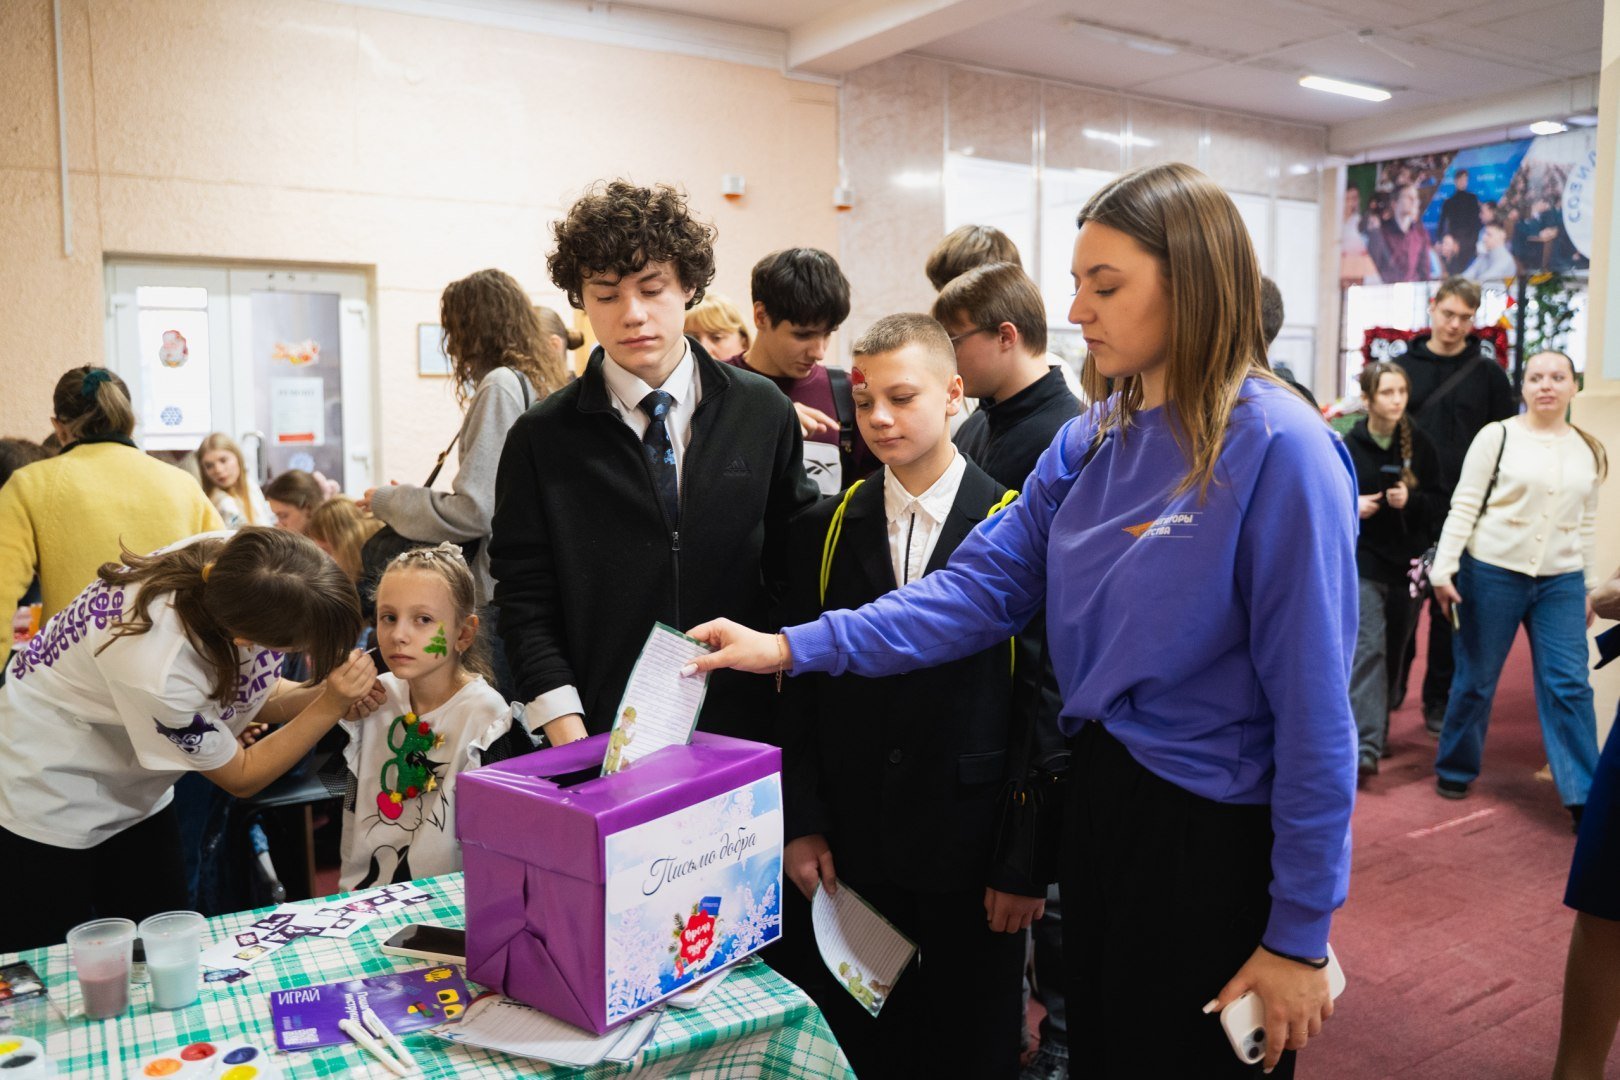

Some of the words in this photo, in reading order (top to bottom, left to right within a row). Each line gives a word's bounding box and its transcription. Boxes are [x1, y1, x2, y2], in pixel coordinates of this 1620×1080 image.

[642, 850, 716, 896] Письмо
[719, 826, 757, 861] добра
[277, 987, 321, 1006] ИГРАЙ
